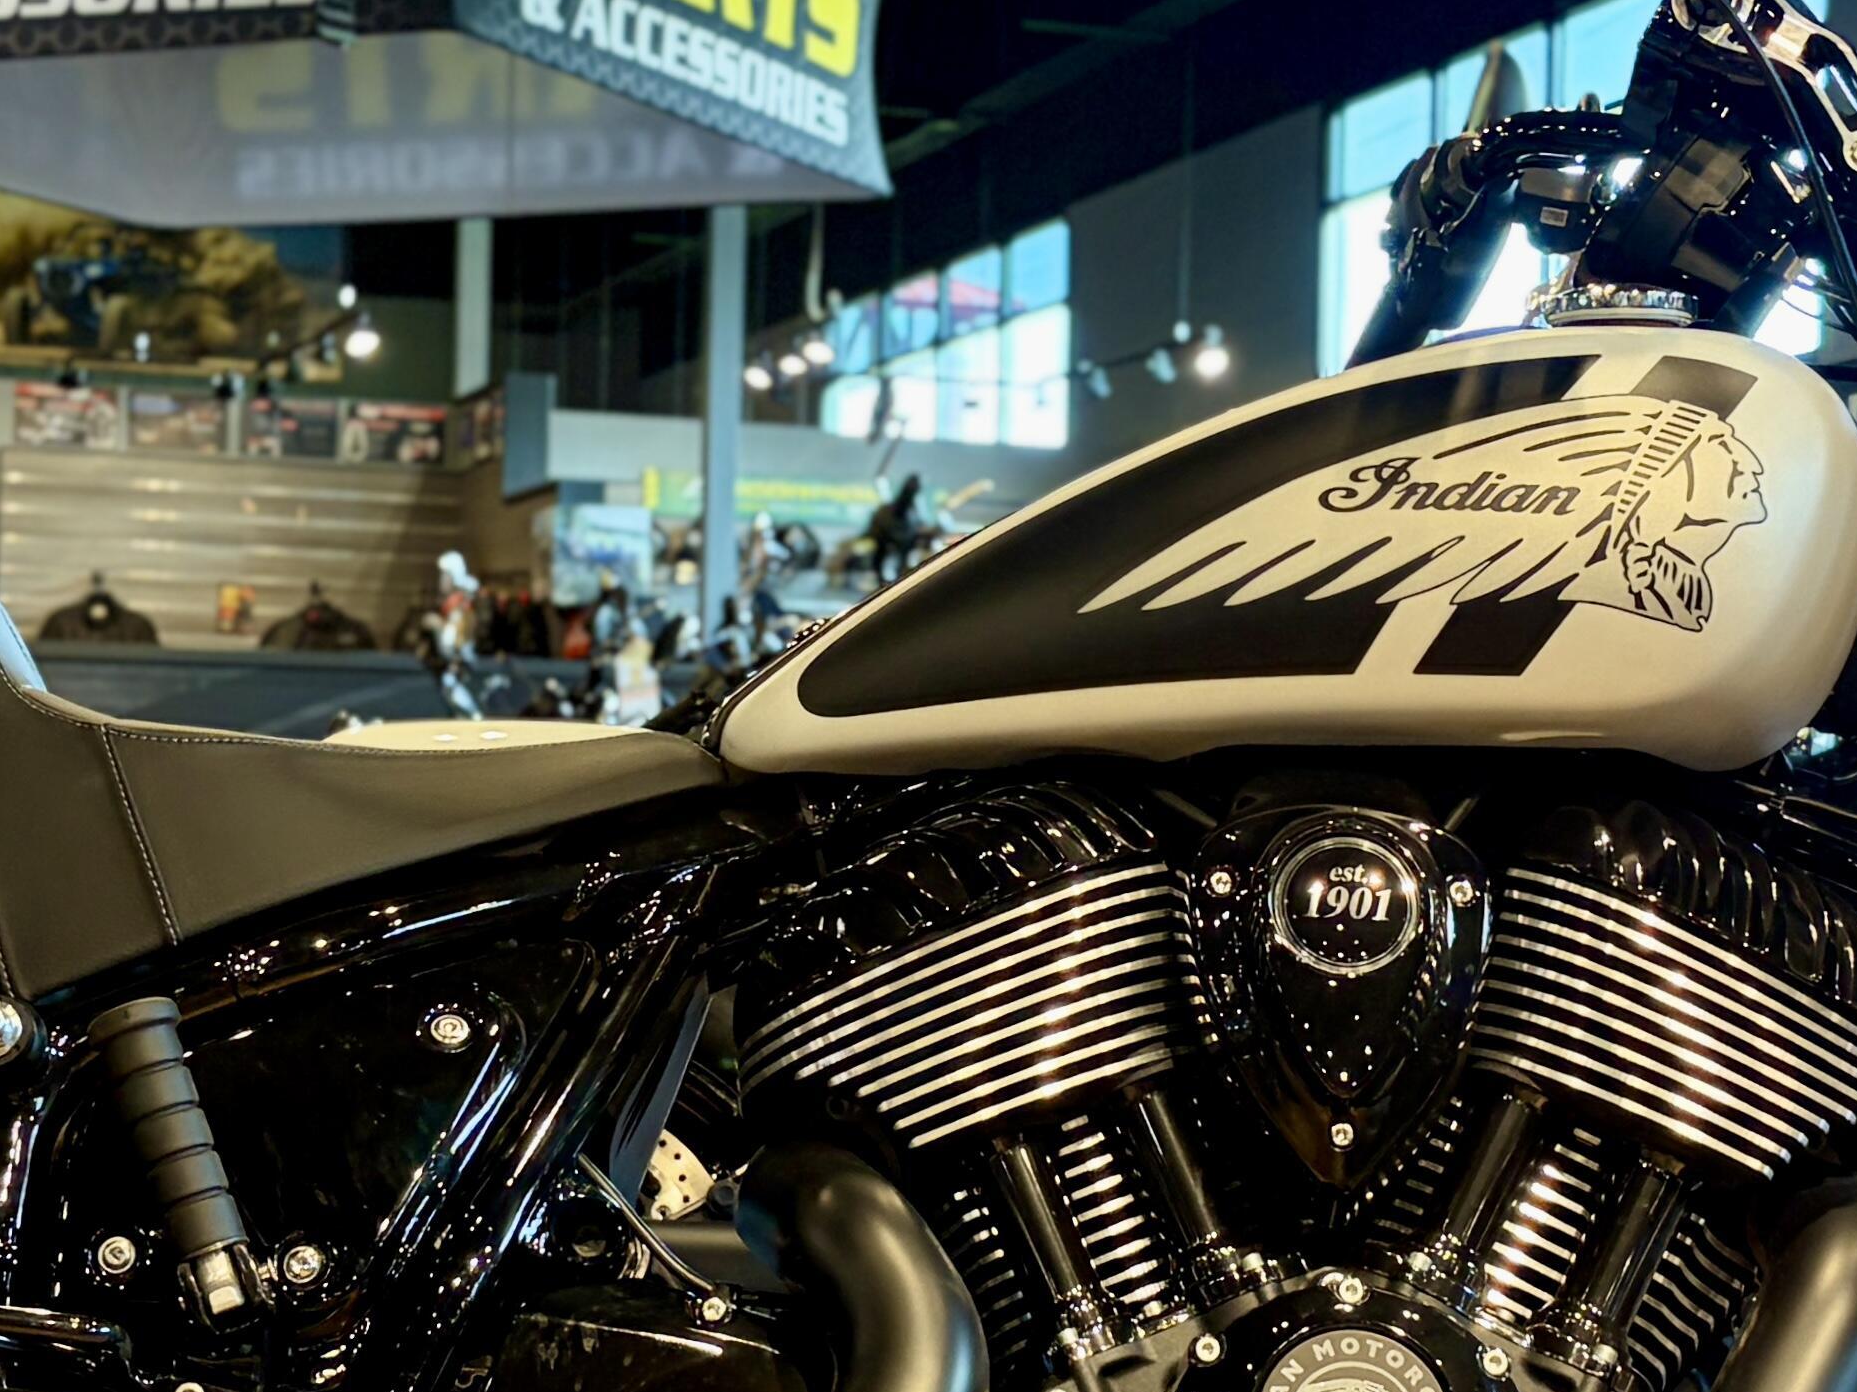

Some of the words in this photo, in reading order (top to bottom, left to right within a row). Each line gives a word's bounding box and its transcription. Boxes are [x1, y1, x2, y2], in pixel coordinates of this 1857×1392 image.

[1318, 456, 1581, 516] Indian
[1328, 862, 1371, 884] est.
[1304, 885, 1392, 922] 1901
